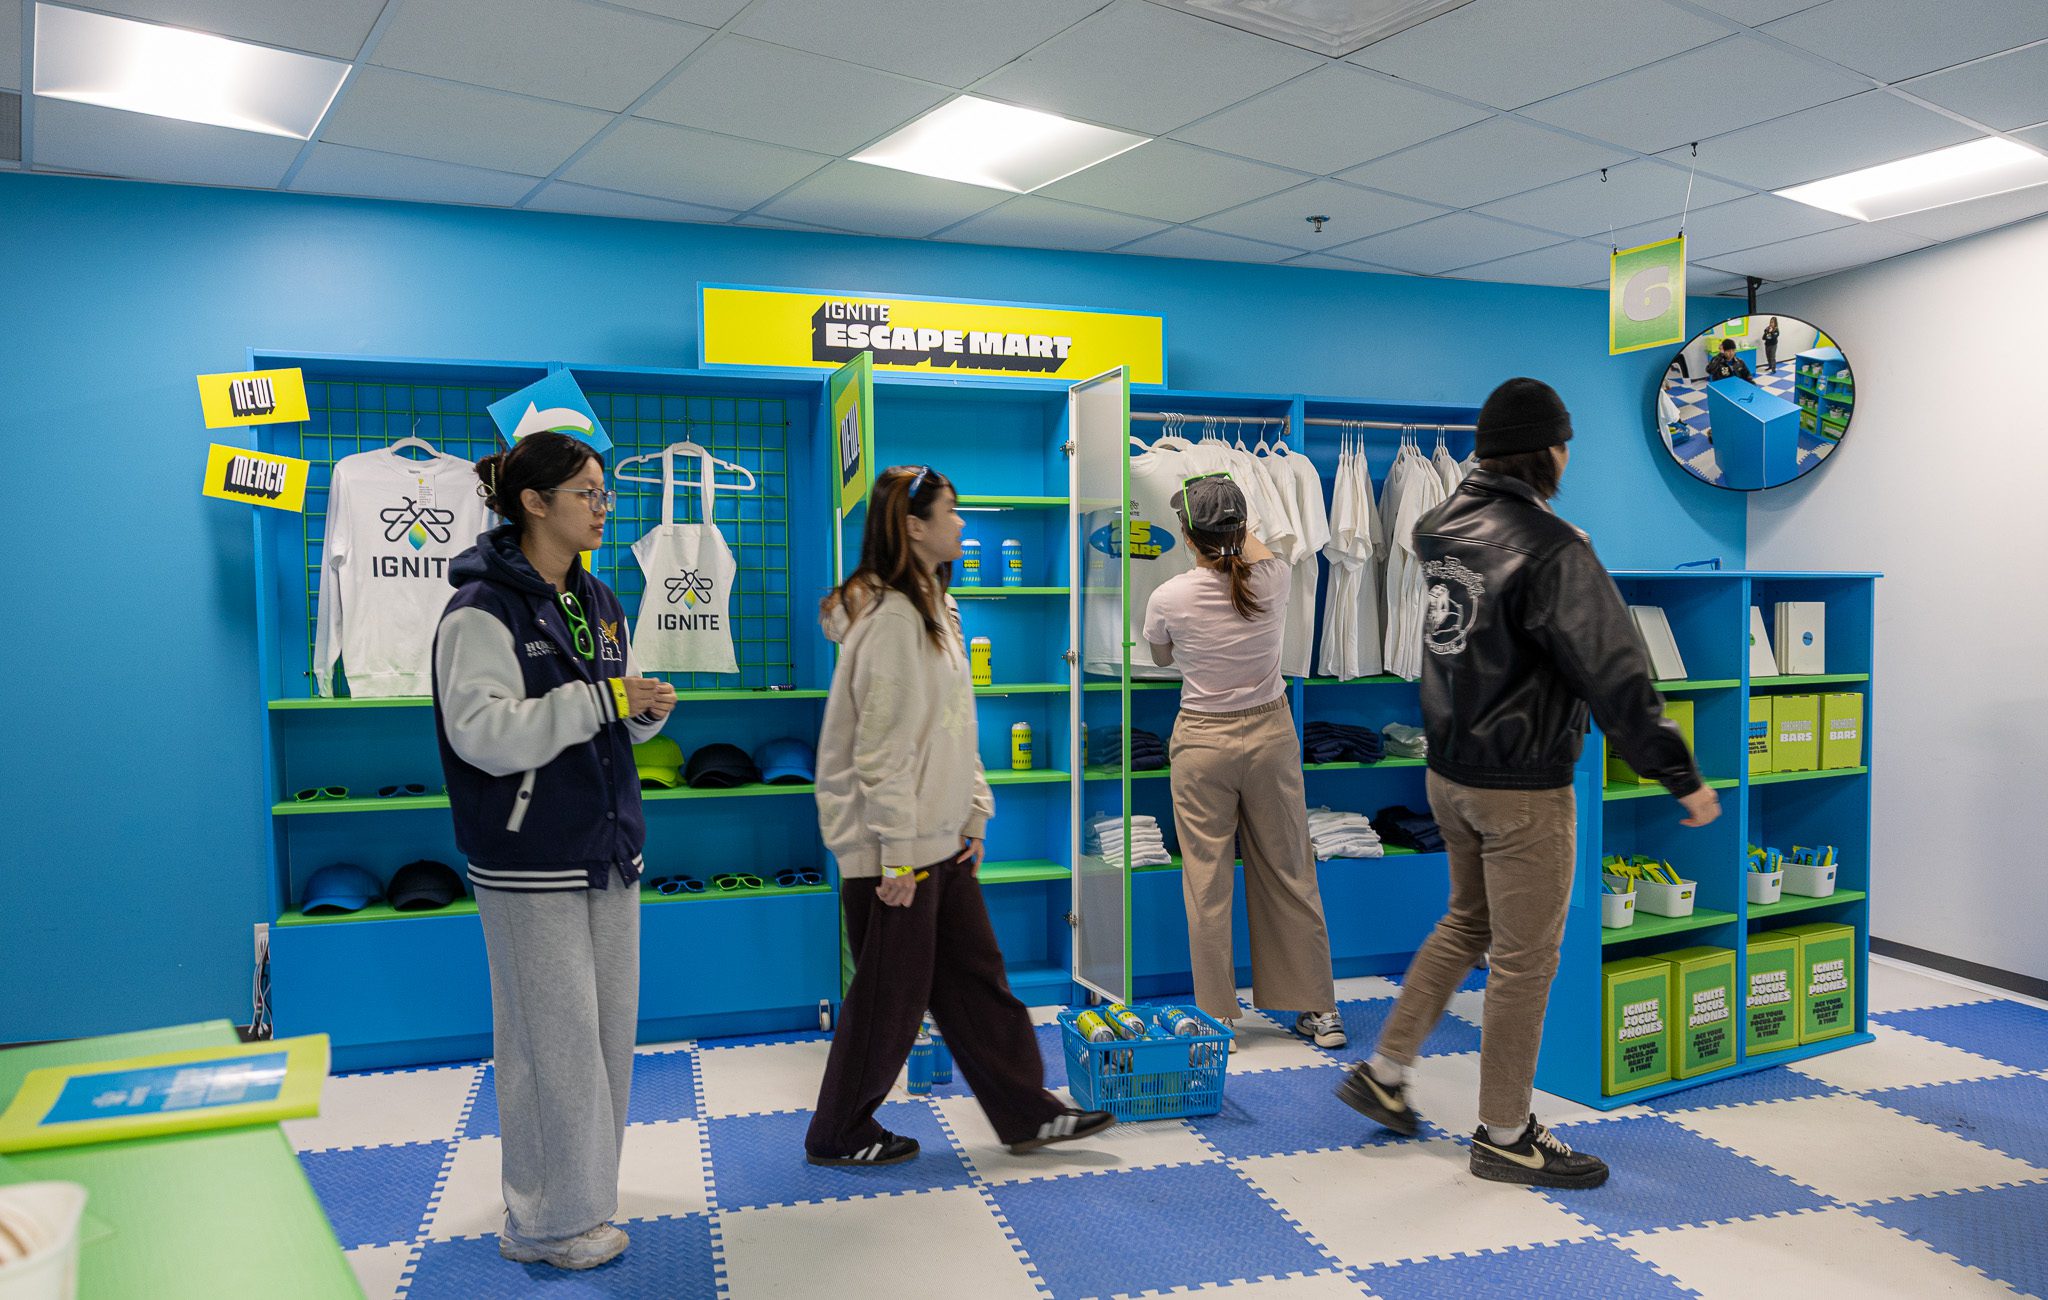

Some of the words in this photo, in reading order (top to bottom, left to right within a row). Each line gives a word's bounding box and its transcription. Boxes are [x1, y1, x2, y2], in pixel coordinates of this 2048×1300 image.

[1623, 264, 1671, 321] 6
[824, 301, 890, 321] IGNITE
[825, 322, 963, 353] ESCAPE
[969, 331, 1072, 358] MART
[231, 376, 276, 411] NEW!
[230, 455, 287, 493] MERCH
[1110, 543, 1162, 556] YARS
[373, 556, 453, 578] IGNIT
[658, 614, 720, 630] IGNITE
[1780, 732, 1812, 742] BARS
[1830, 730, 1856, 740] BARS
[1813, 960, 1844, 975] IGNITE
[1751, 971, 1787, 986] IGNITE
[1814, 970, 1843, 985] FOCUS
[1694, 987, 1725, 1004] IGNITE
[1752, 981, 1786, 996] FOCUS
[1809, 979, 1848, 996] PHONES
[1694, 998, 1724, 1015] FOCUS
[1746, 991, 1791, 1007] PHONES
[1624, 999, 1658, 1017] IGNITE
[1625, 1010, 1657, 1028] FOCUS
[1689, 1008, 1728, 1027] PHONES
[1619, 1020, 1663, 1040] PHONES
